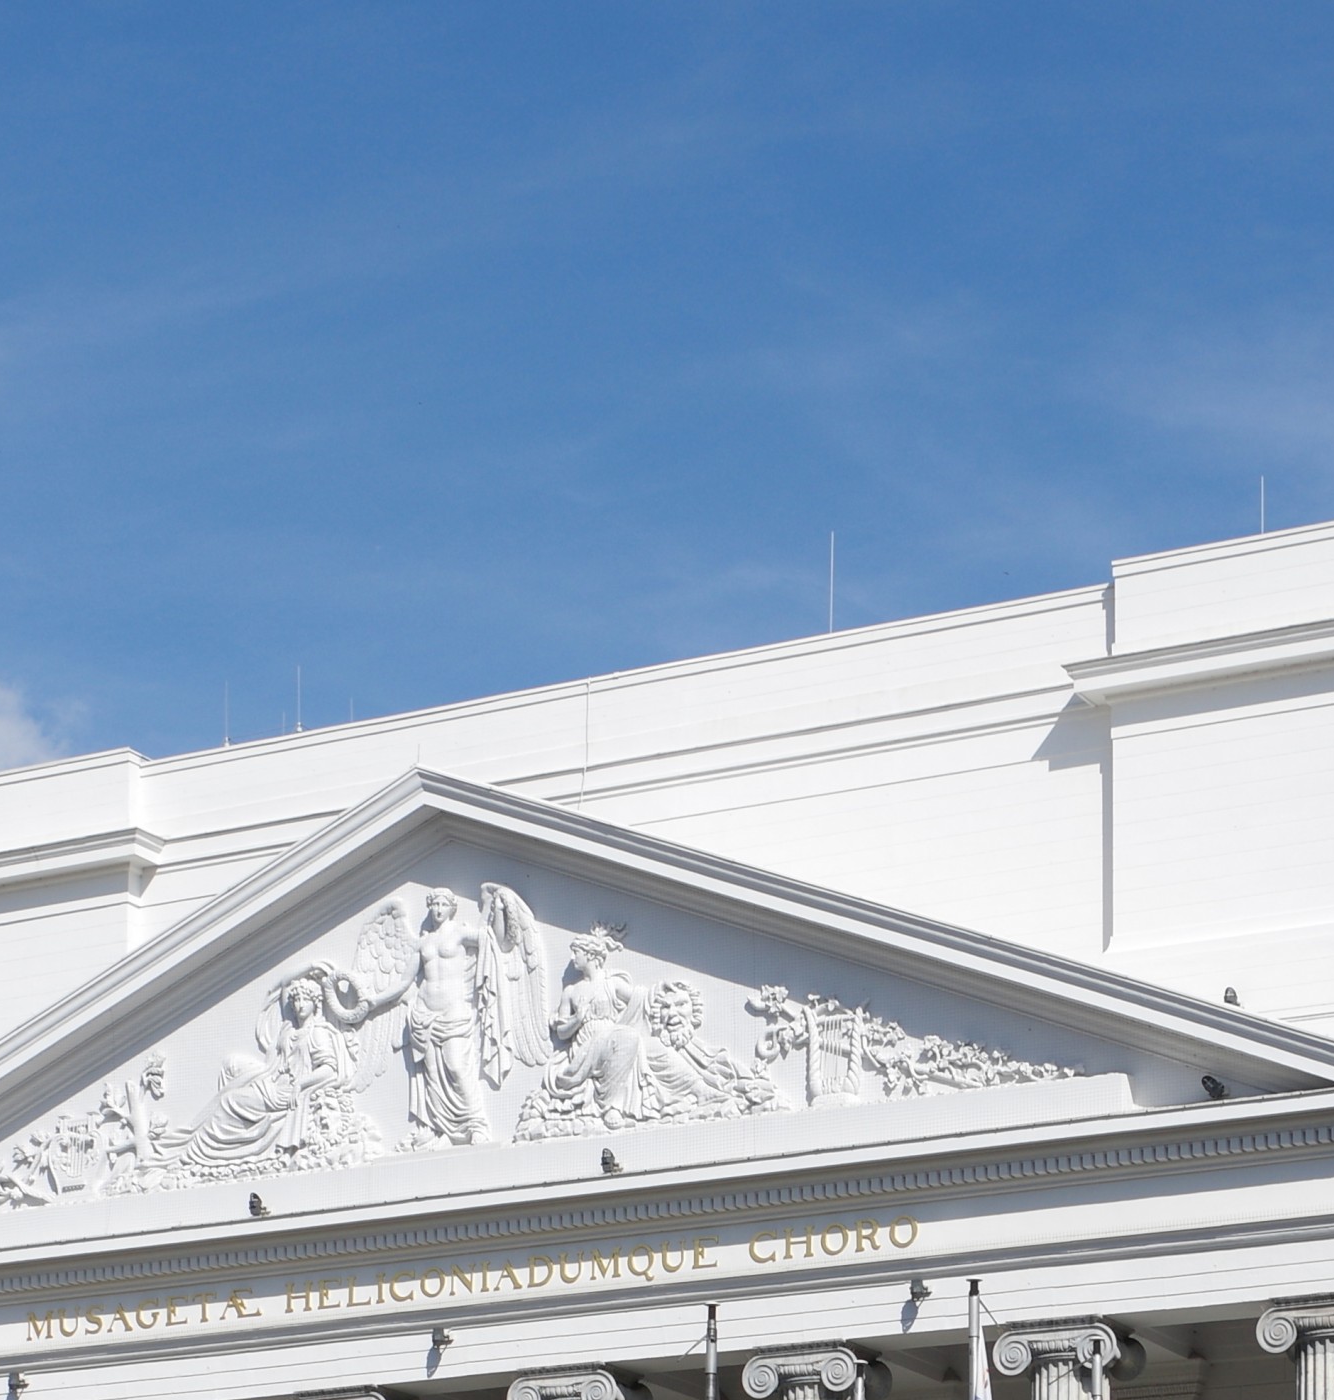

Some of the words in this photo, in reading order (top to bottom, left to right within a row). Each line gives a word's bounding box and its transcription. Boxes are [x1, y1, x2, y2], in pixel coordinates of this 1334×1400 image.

[26, 1287, 262, 1342] MUSAGETÆ
[284, 1234, 720, 1314] HELICONIADUMQUE
[748, 1214, 919, 1264] CHORO
